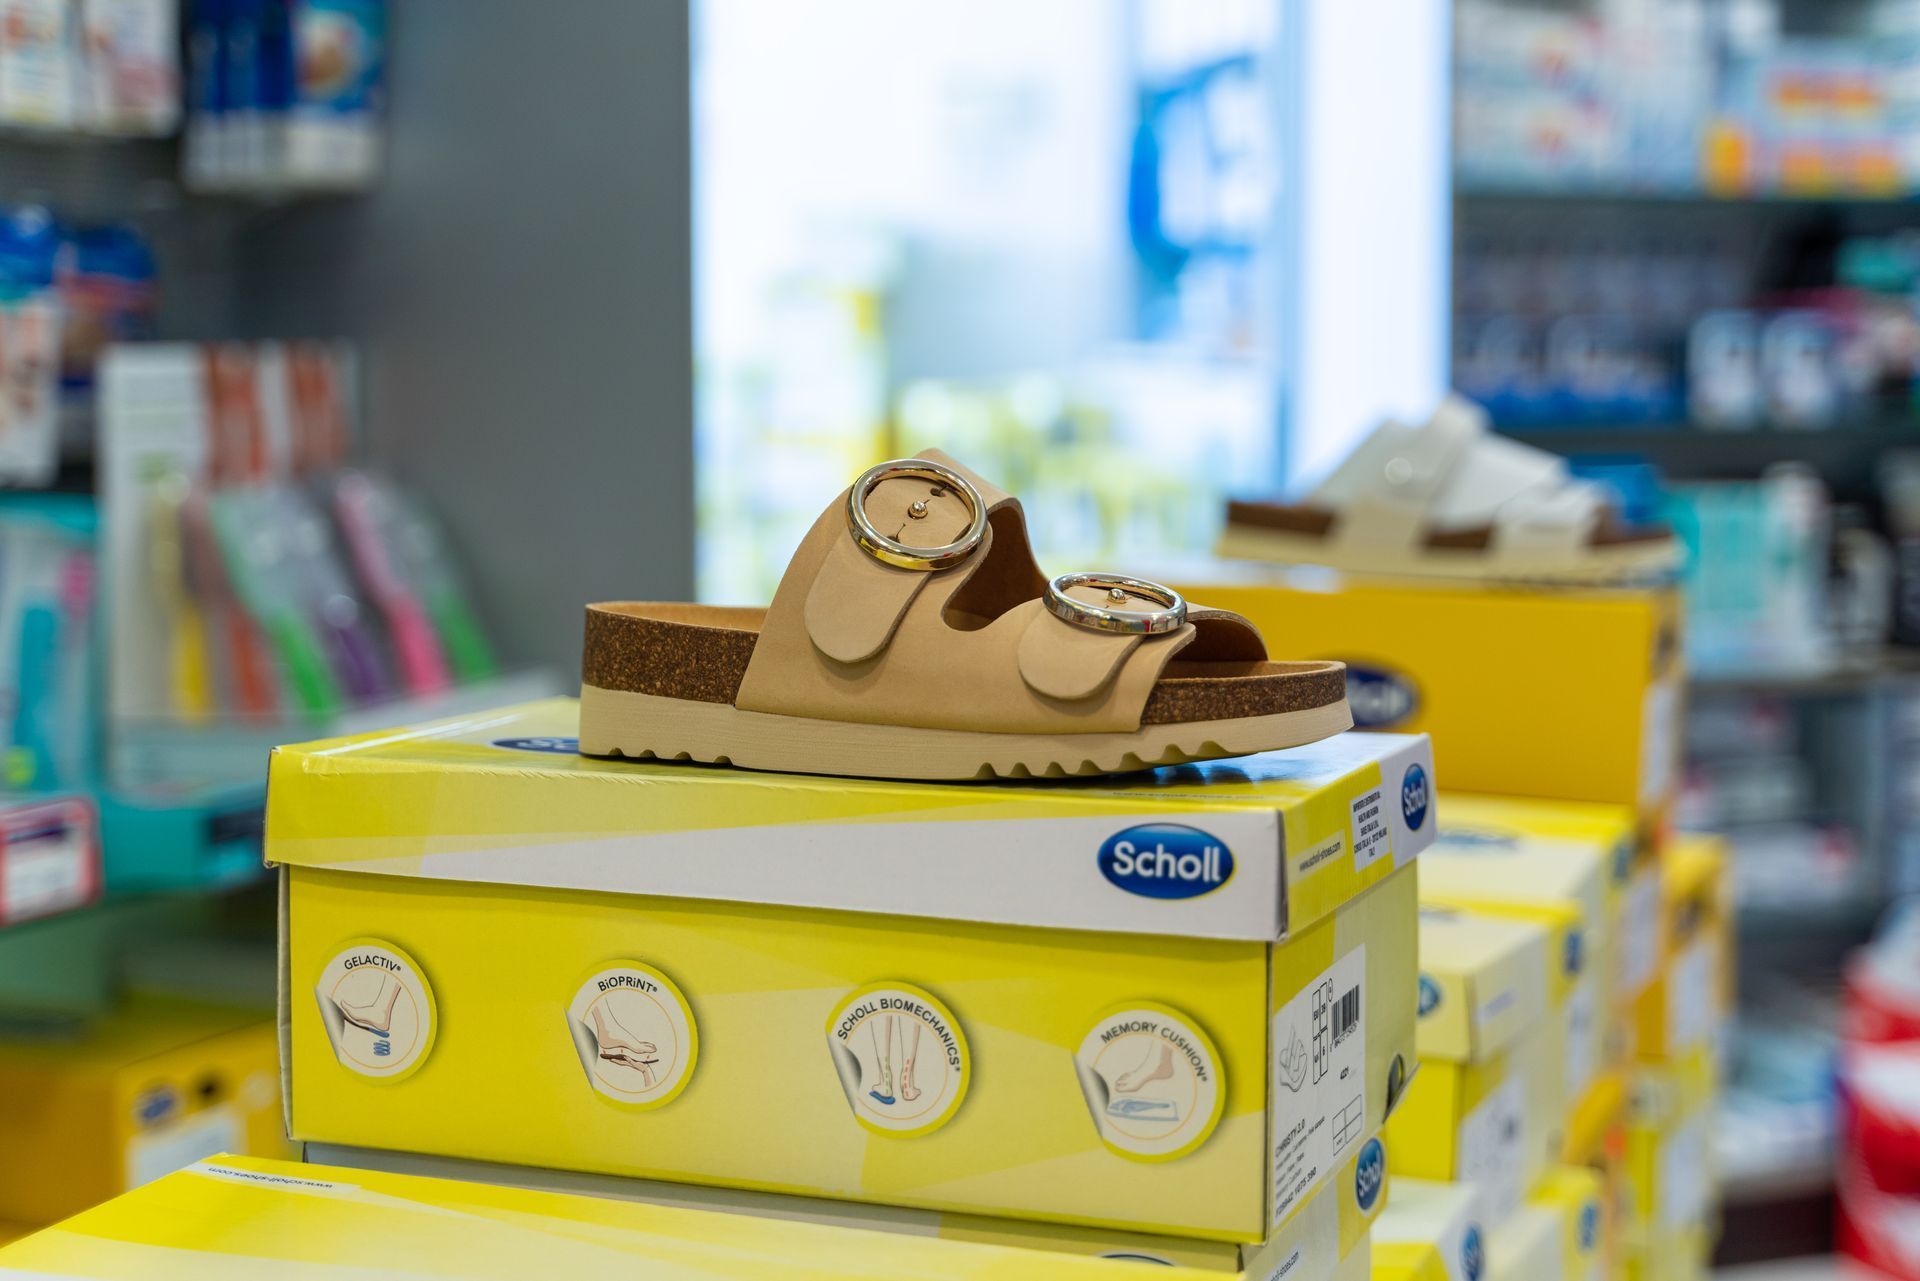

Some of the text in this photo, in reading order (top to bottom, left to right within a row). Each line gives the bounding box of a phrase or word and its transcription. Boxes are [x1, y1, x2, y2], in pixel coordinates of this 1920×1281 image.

[1403, 777, 1426, 816] Scholl
[1112, 840, 1221, 882] Scholl
[837, 1001, 878, 1040] SCHOLL
[1100, 1021, 1158, 1044] MEMORY
[208, 1167, 333, 1189] www.scholl-shoes.com
[1358, 1148, 1381, 1198] Scholl
